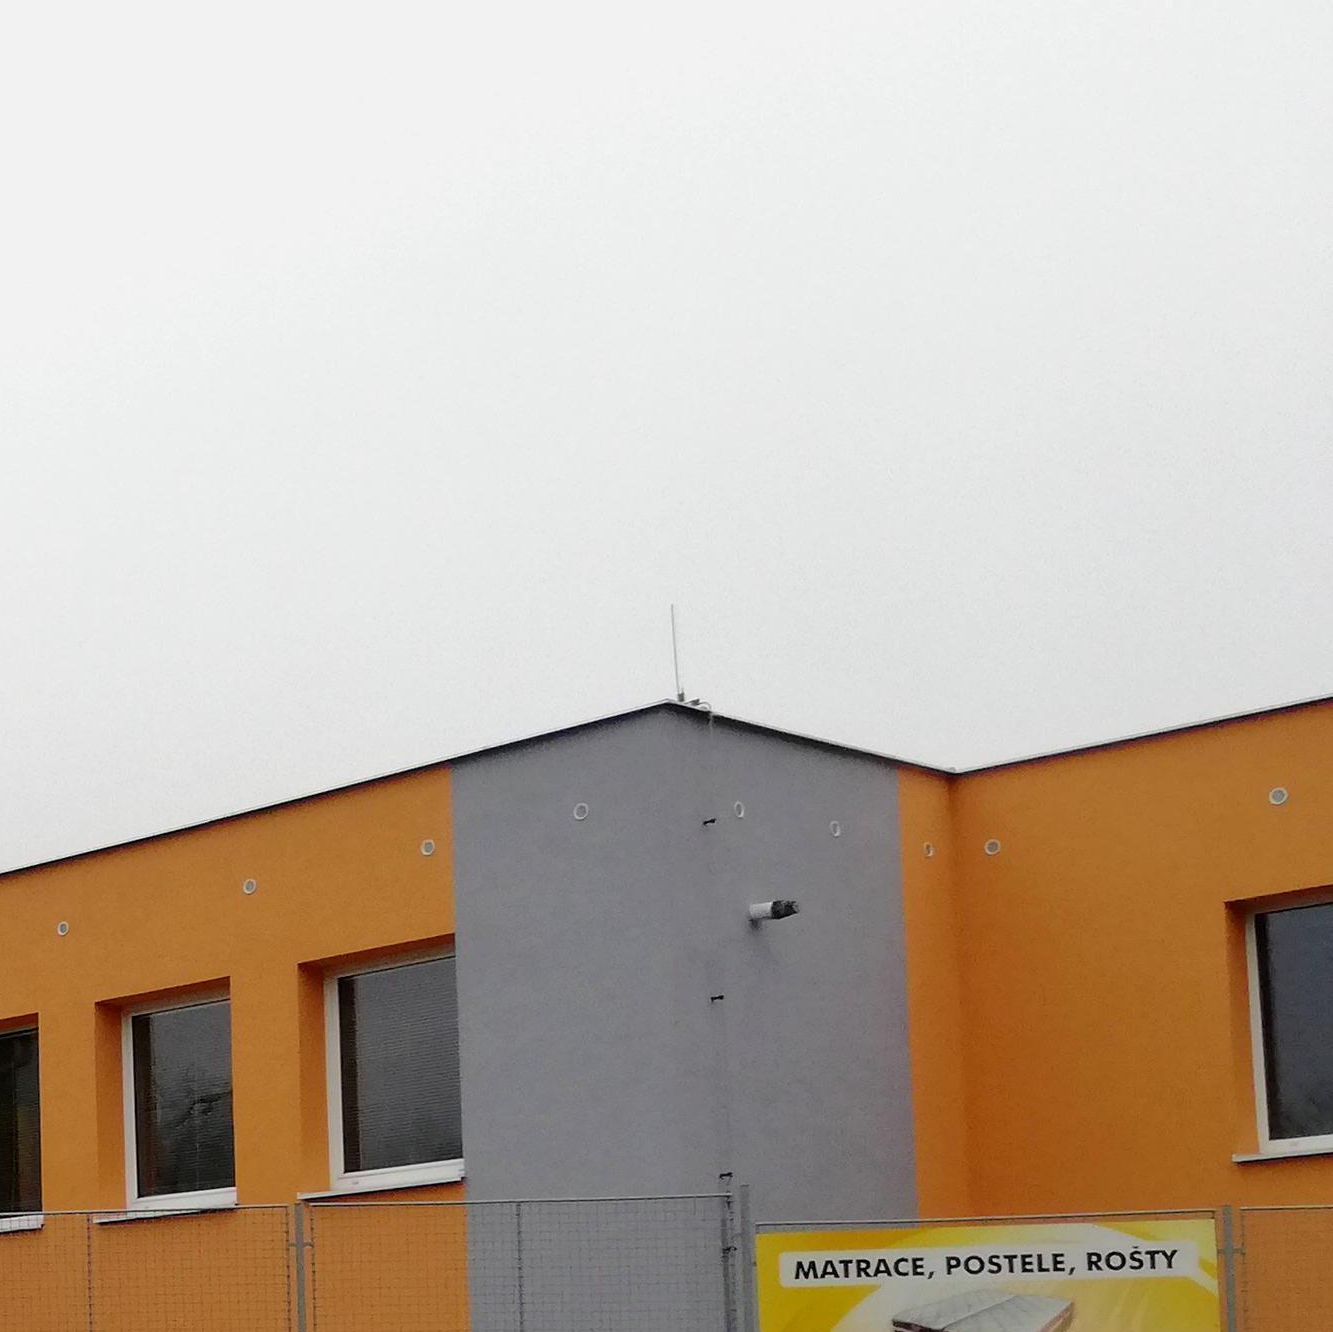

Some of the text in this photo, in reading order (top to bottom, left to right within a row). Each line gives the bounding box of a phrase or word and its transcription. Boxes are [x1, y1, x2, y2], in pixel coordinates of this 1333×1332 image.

[794, 1246, 1178, 1280] MATRACE, POSTELE, ROŠTY
